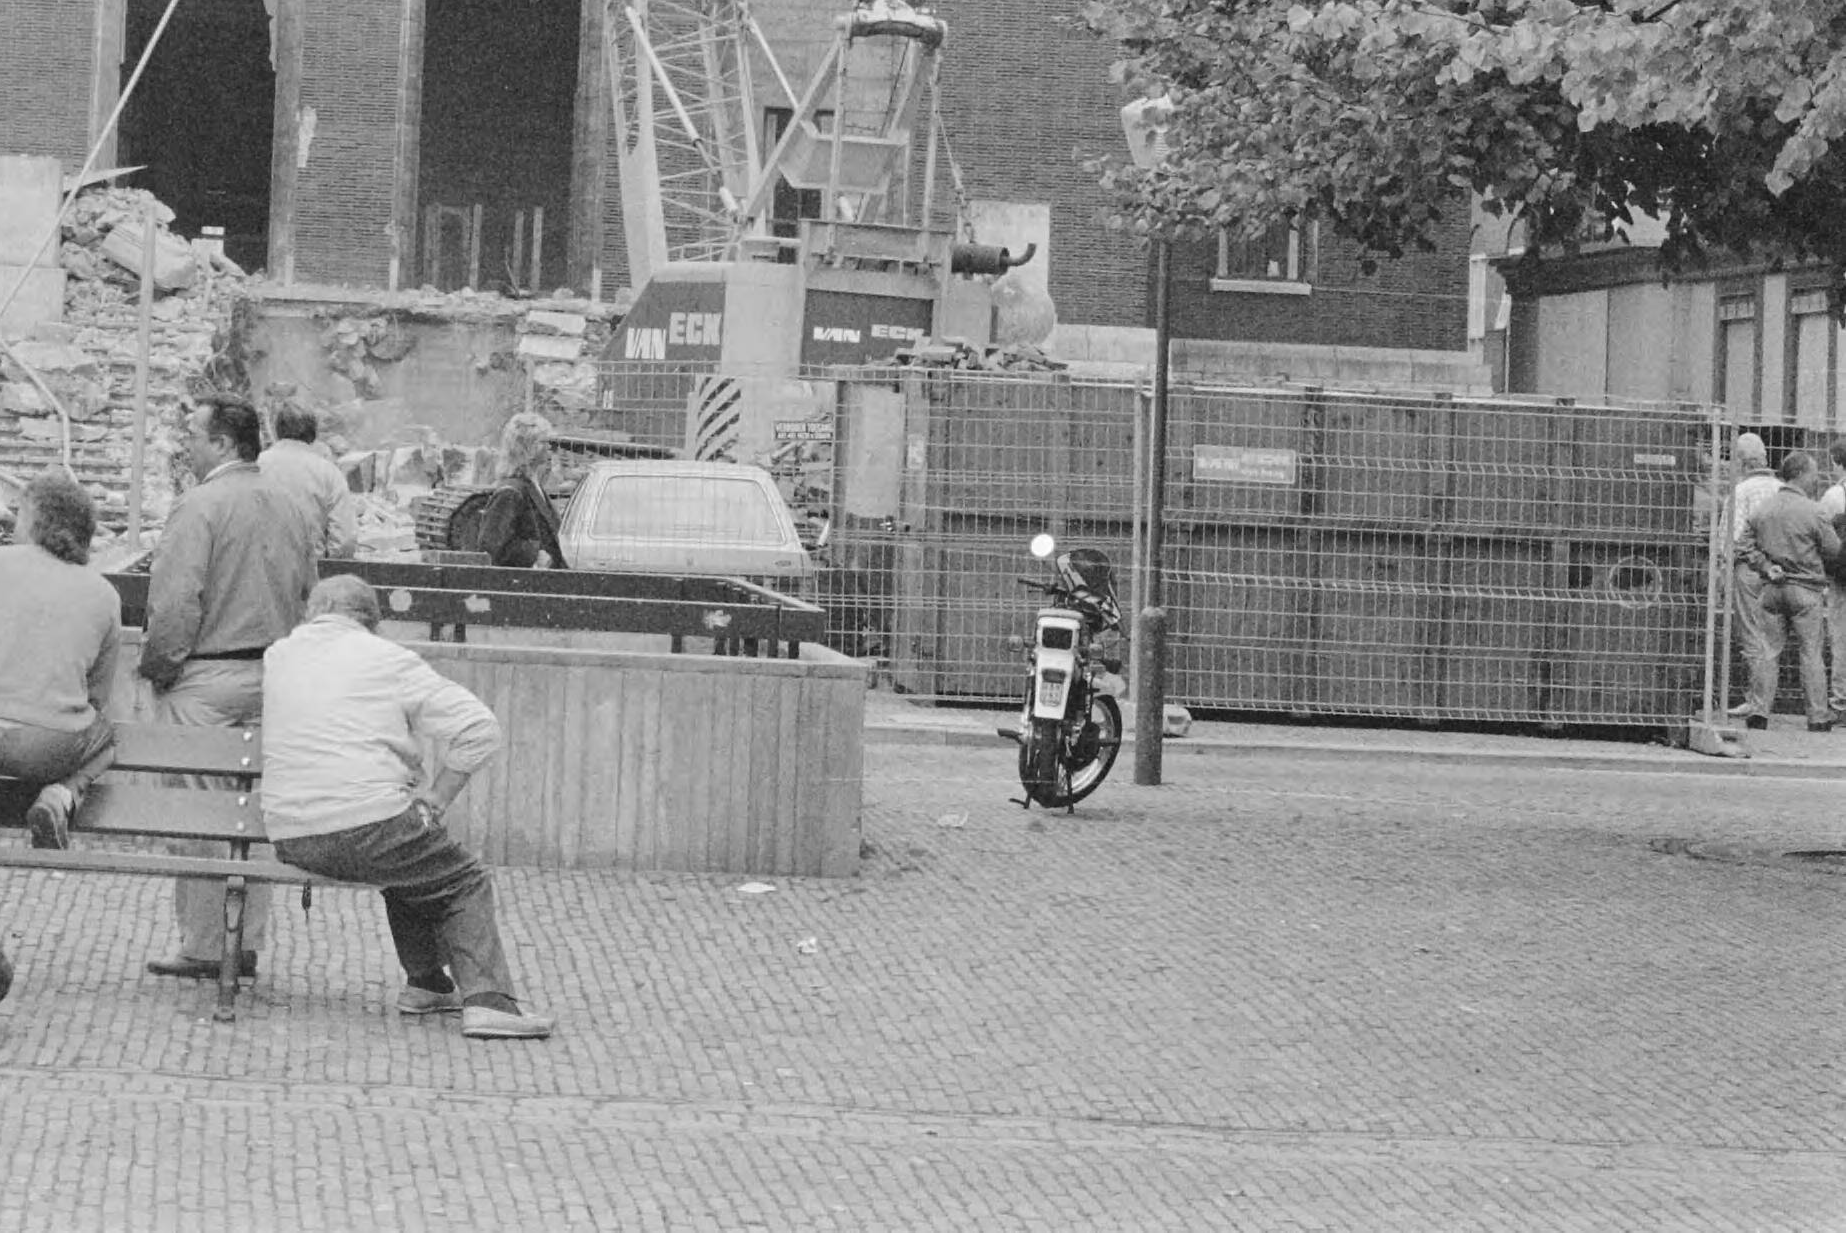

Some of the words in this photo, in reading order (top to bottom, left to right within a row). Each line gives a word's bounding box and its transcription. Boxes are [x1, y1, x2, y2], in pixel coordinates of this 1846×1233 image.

[625, 327, 666, 360] VAN
[669, 312, 722, 345] ECK
[813, 326, 860, 343] VAN
[871, 324, 924, 341] ECK
